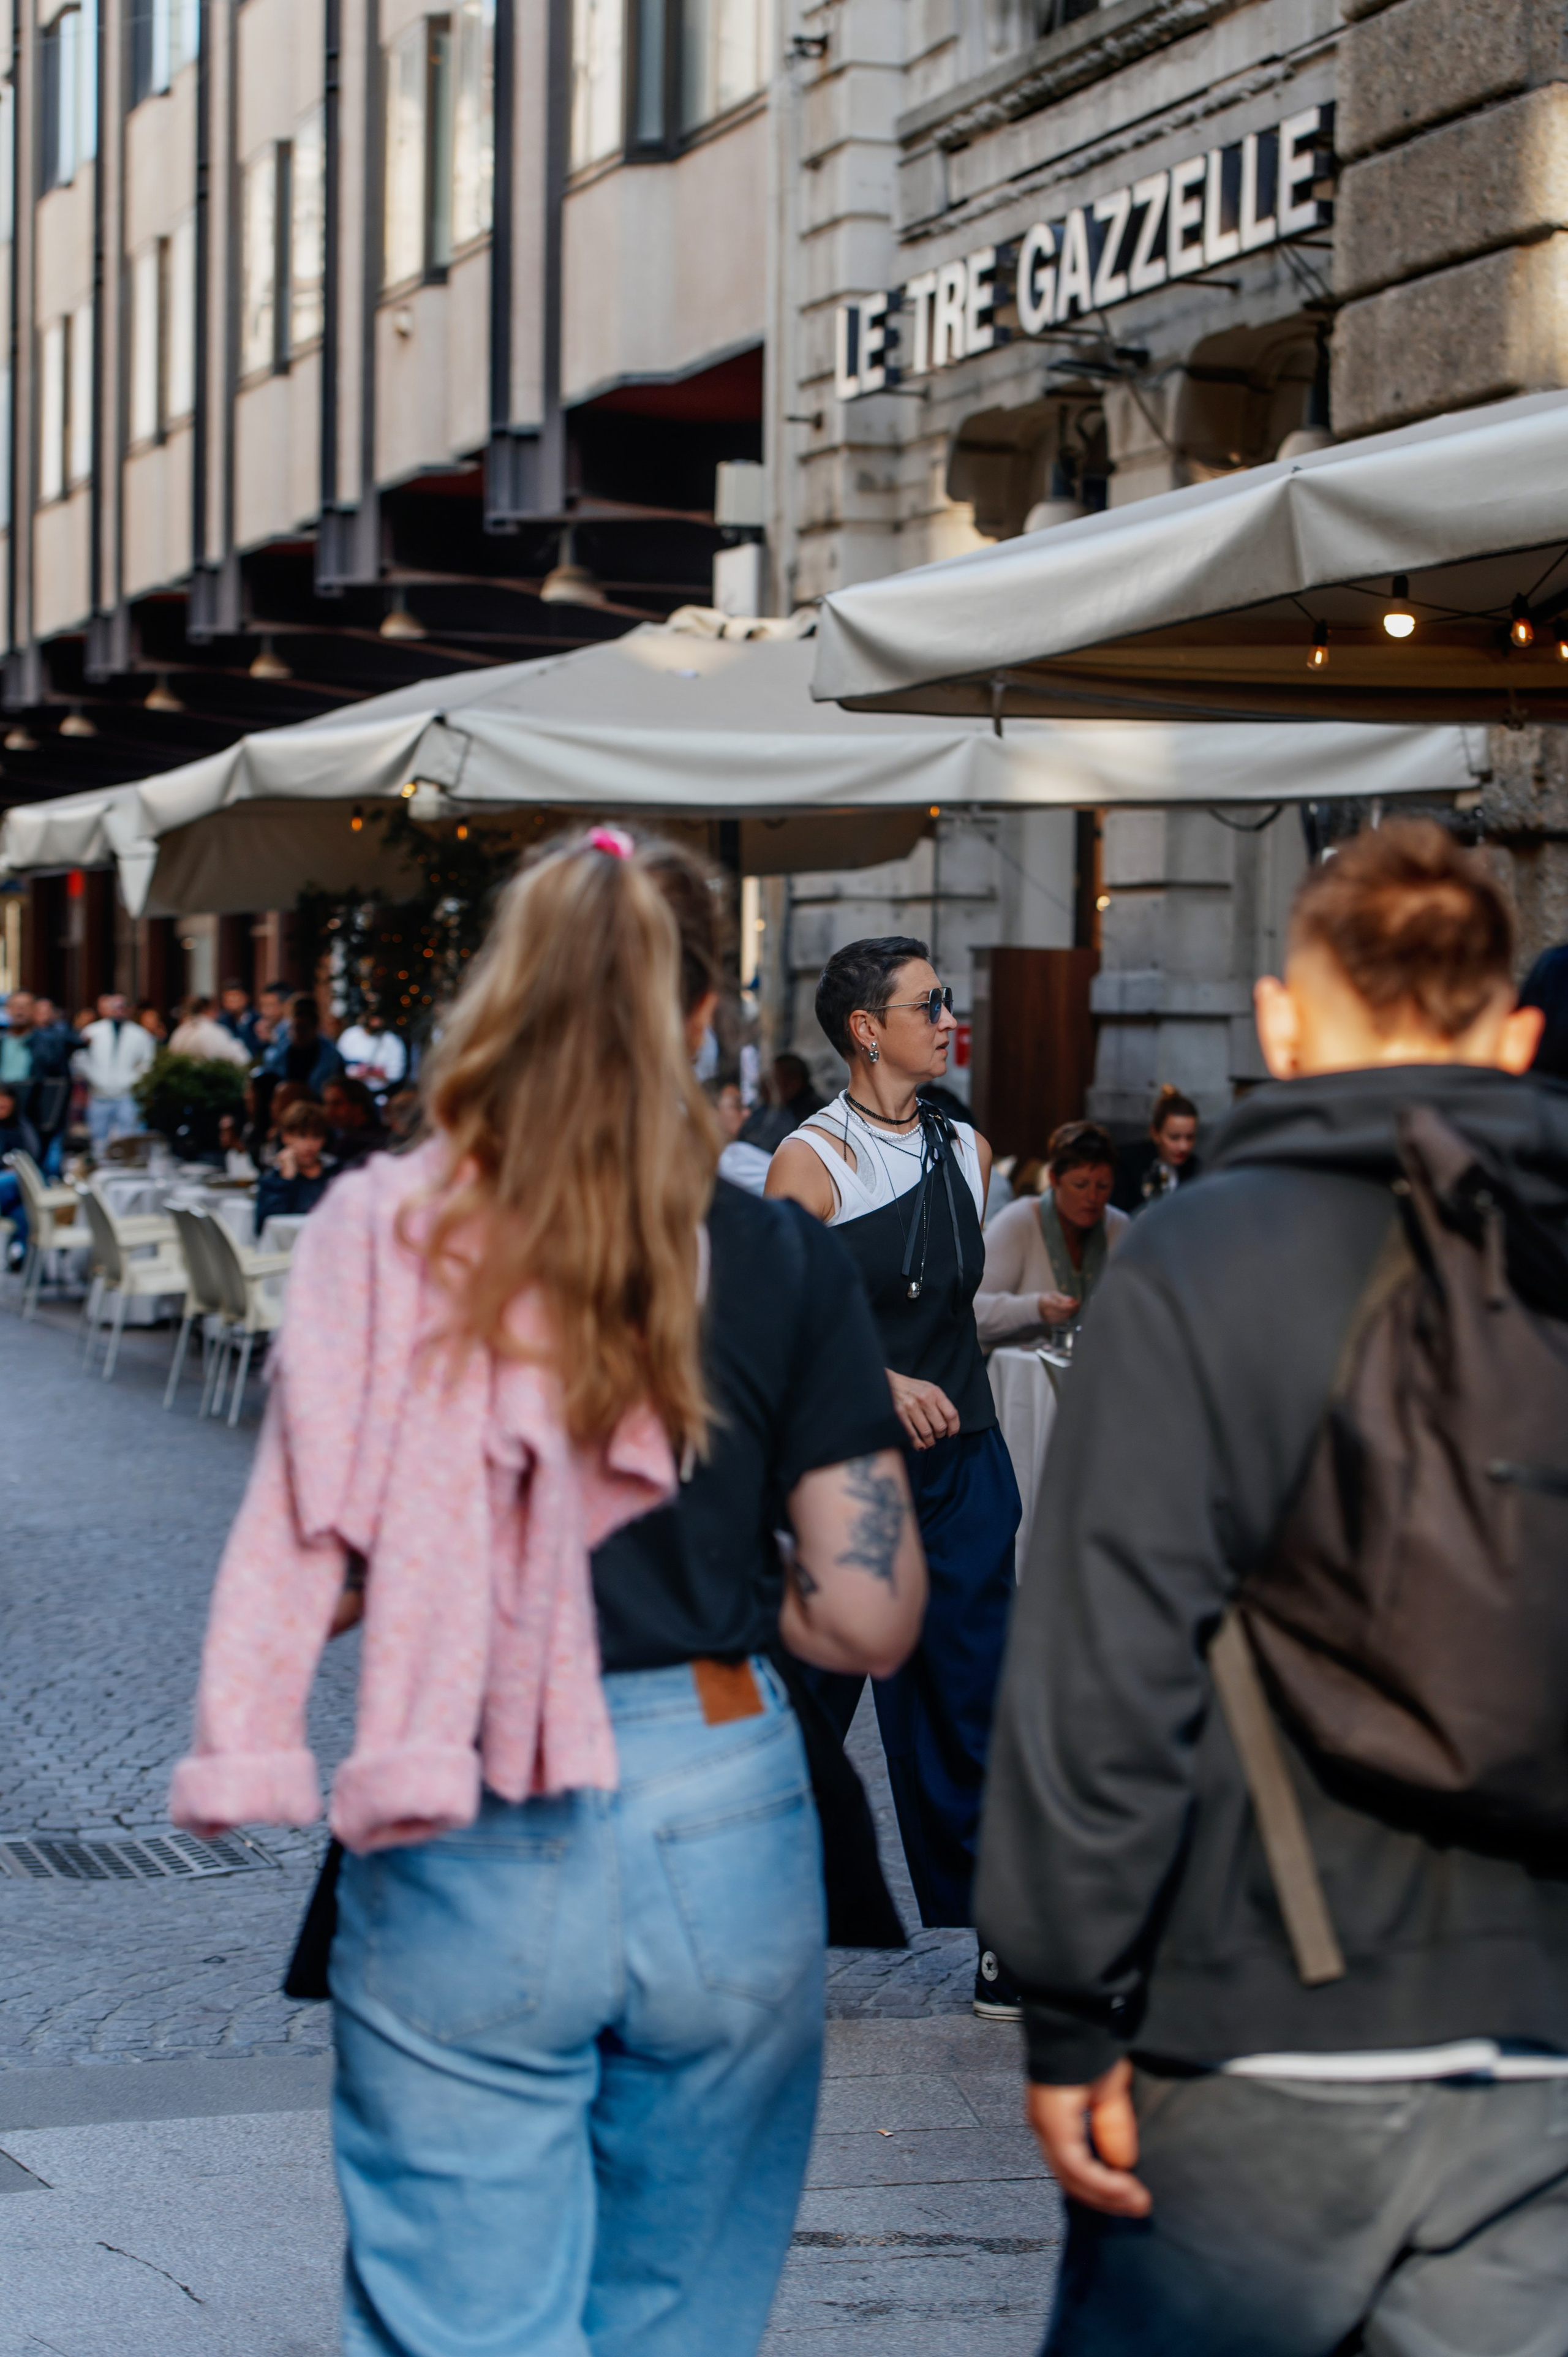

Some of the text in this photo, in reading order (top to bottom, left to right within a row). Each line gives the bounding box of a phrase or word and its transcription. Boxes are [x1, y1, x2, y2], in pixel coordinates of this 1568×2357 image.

[835, 106, 1322, 399] LE TRE GAZZELLE
